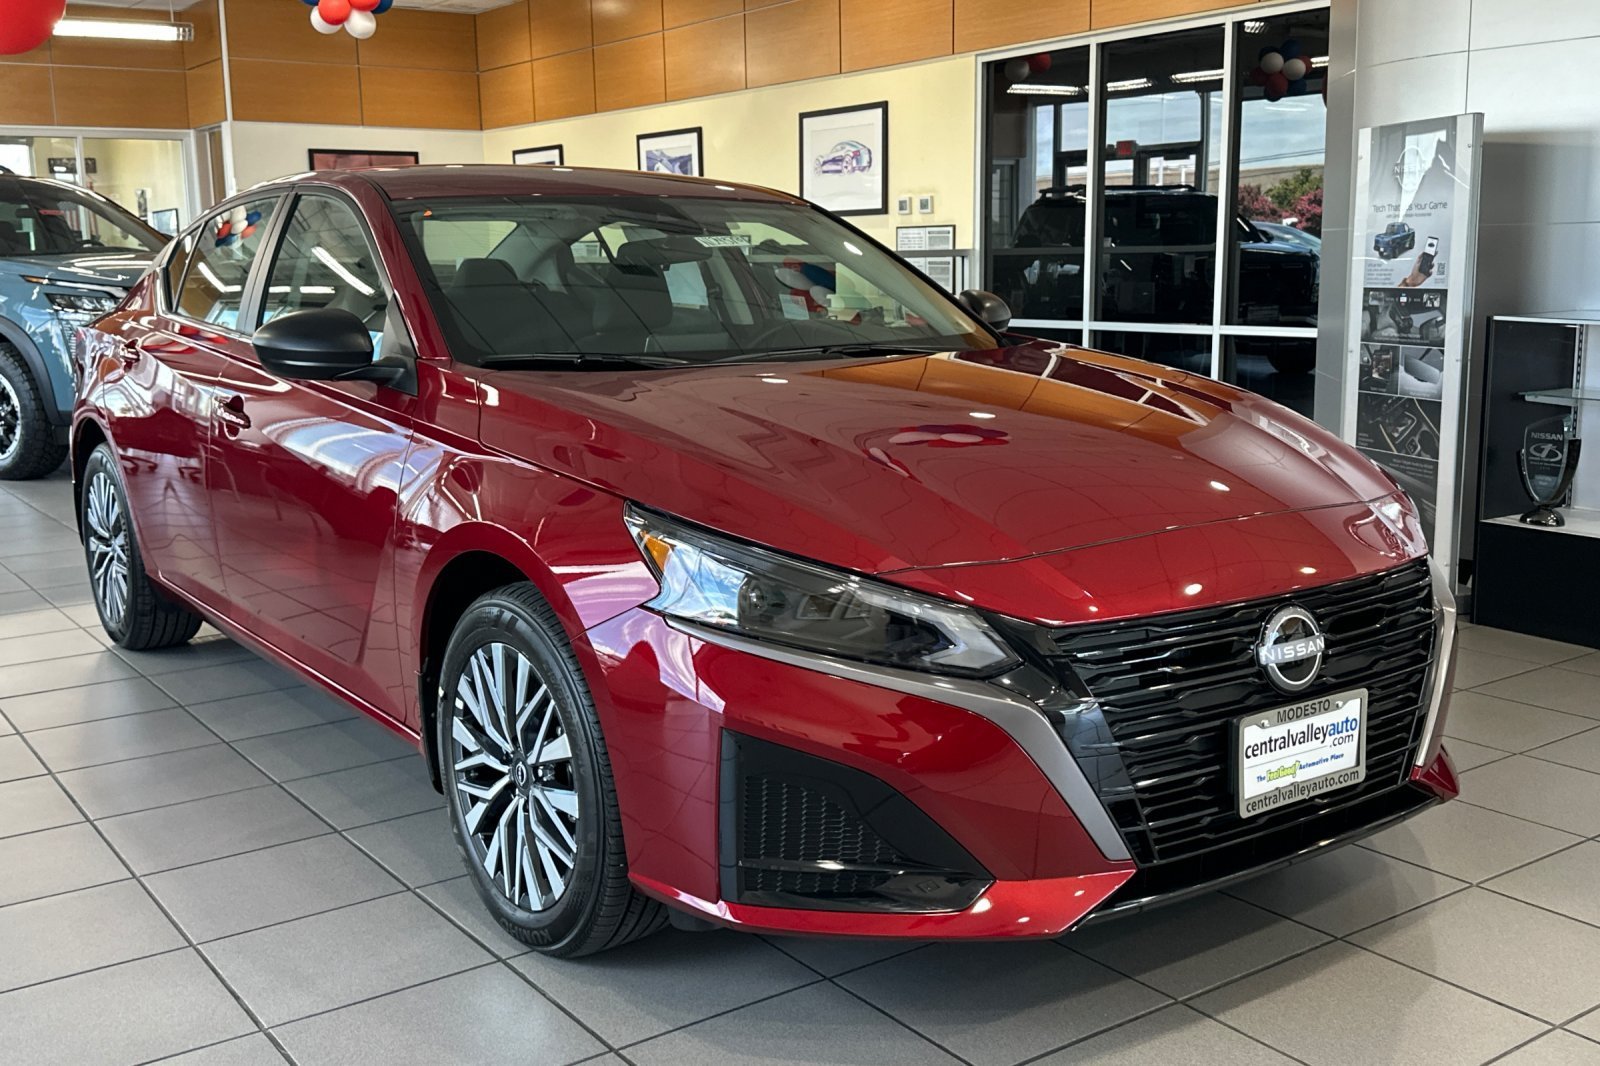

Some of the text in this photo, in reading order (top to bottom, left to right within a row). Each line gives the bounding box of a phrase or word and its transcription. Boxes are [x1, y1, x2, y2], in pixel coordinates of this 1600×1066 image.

[1372, 204, 1386, 212] Tech
[1414, 202, 1428, 210] Your
[1429, 201, 1448, 210] Game
[1531, 432, 1563, 440] NISSAN
[1263, 637, 1325, 661] NISSAN
[1277, 699, 1330, 723] MODESTO
[1245, 717, 1358, 759] centralvalleyauto
[1330, 734, 1354, 748] .com
[1299, 757, 1329, 769] Automotive
[1246, 770, 1359, 813] centralvalleyauto.com
